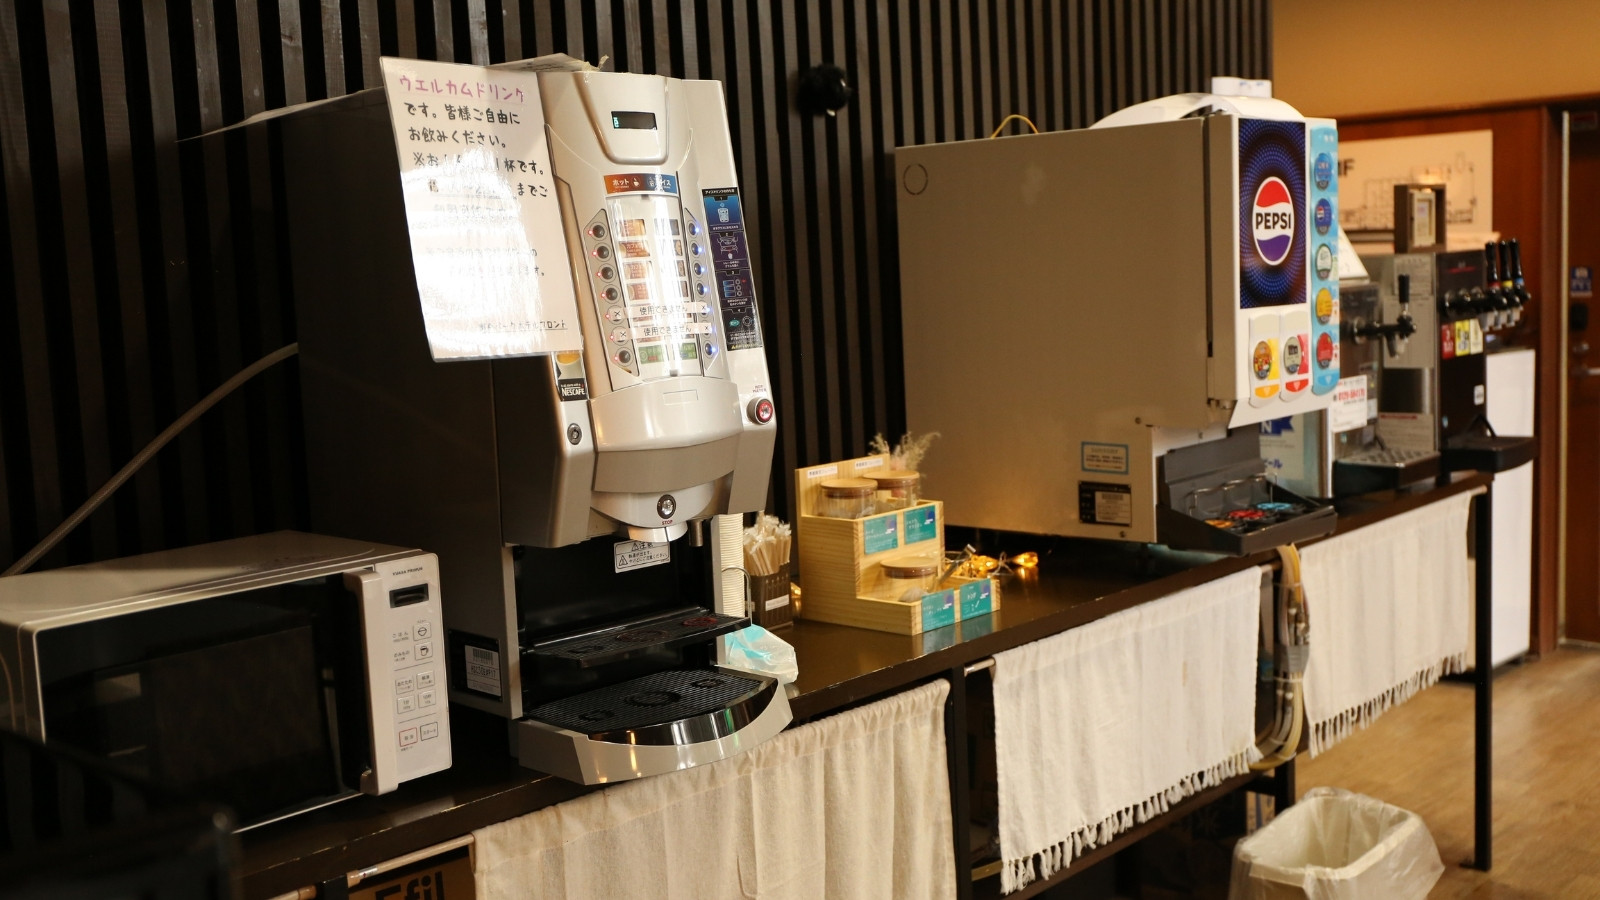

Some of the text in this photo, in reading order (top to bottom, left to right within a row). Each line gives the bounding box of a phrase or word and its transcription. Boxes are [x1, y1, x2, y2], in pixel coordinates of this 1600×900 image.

[408, 127, 507, 148] お飲みください。
[1255, 211, 1292, 232] PEPSI
[639, 303, 688, 316] 使用できません
[643, 325, 692, 337] 使用できません
